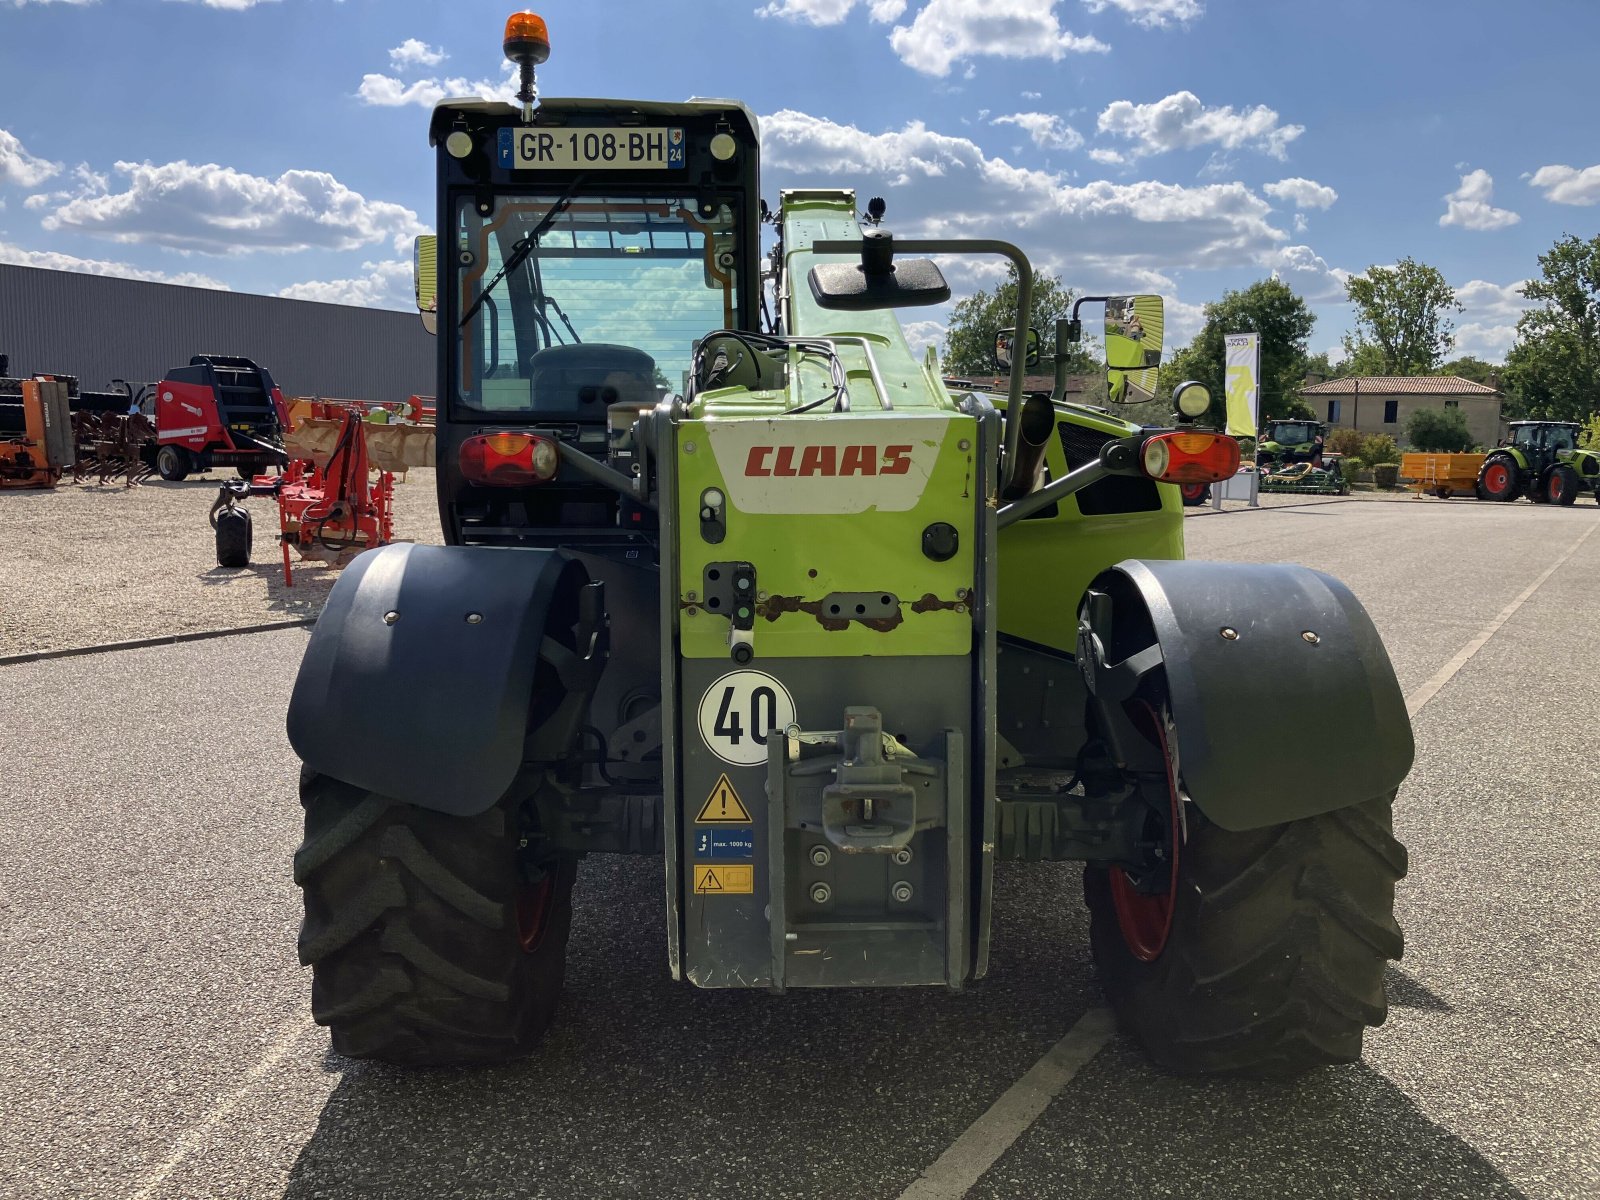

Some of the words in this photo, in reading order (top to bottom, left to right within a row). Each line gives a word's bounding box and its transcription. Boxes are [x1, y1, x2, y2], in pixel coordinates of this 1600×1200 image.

[503, 150, 508, 158] F
[520, 133, 663, 162] GR-108-BH
[670, 148, 682, 162] 24
[744, 445, 913, 476] CLAAS
[713, 686, 777, 746] 40
